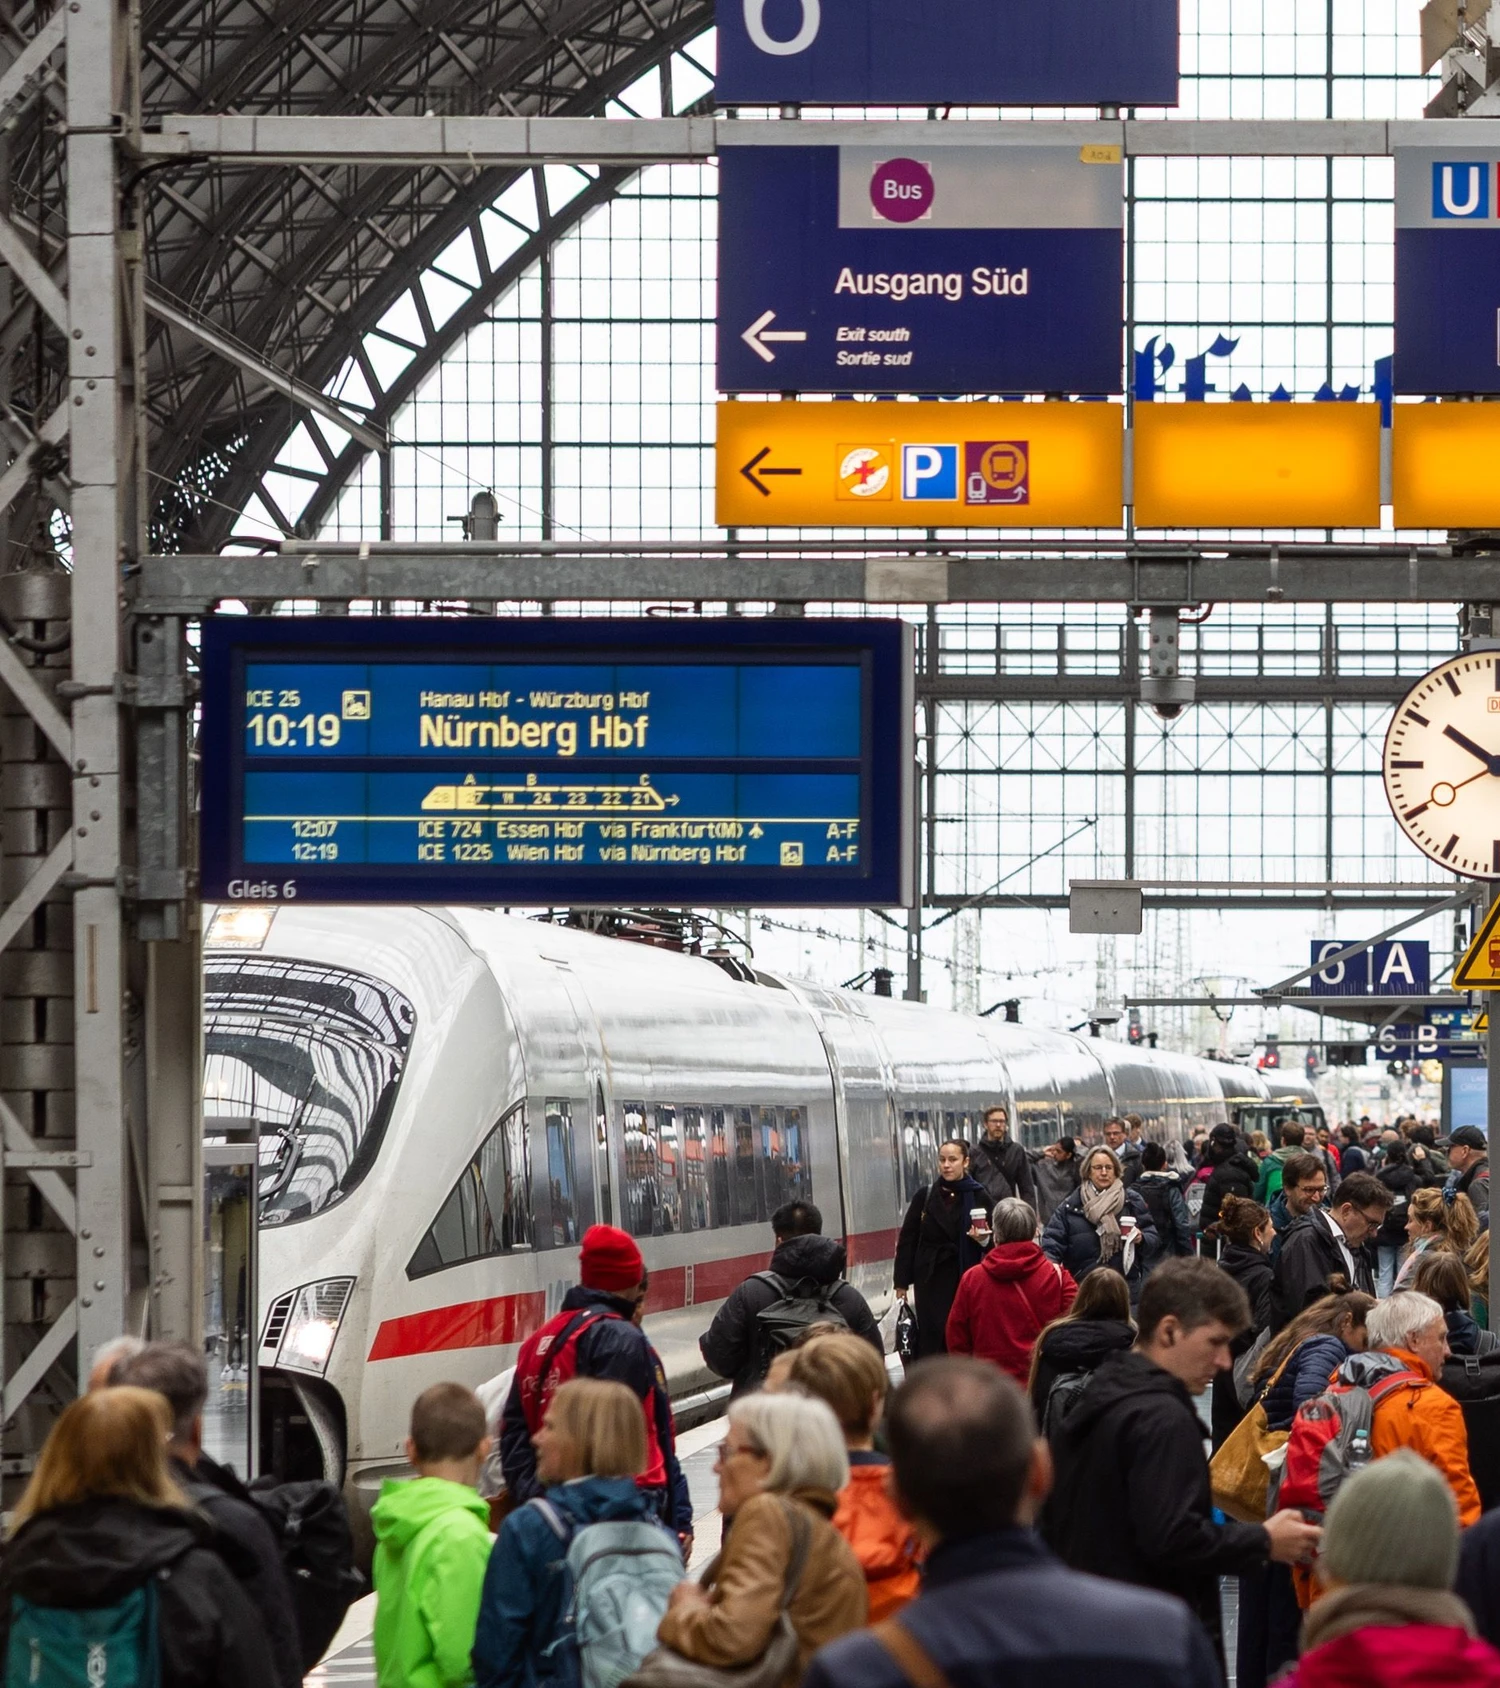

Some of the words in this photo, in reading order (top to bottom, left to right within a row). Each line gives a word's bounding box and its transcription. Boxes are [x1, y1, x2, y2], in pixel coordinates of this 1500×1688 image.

[884, 180, 922, 199] Bus
[1443, 167, 1479, 215] U
[835, 268, 962, 300] Ausgang
[972, 268, 1027, 295] Süd
[836, 327, 866, 342] Exit
[868, 328, 910, 342] south
[837, 351, 880, 365] Sortie
[883, 352, 912, 365] sud
[906, 447, 943, 498] P
[246, 690, 274, 708] ICE
[279, 690, 300, 707] 25
[421, 692, 474, 707] Hanau
[479, 691, 510, 707] Hbf
[530, 692, 613, 711] Würzburg
[620, 692, 649, 708] Hbf
[247, 714, 341, 746] 10:19
[420, 715, 576, 755] Nürnberg
[591, 716, 648, 747] Hbf
[463, 773, 477, 786] A
[526, 774, 537, 786] B
[639, 774, 650, 786] C
[568, 792, 587, 804] 23
[602, 792, 622, 804] 22
[632, 792, 650, 804] 21
[291, 821, 338, 838] 12:07
[418, 821, 445, 838] ICE
[450, 821, 482, 838] 724
[496, 821, 549, 838] Essen
[555, 823, 585, 839] Hbf
[600, 822, 627, 839] via
[631, 822, 744, 840] Frankfurt(M)
[826, 822, 859, 839] A-F
[291, 844, 338, 860] 12:19
[418, 844, 445, 860] ICE
[451, 844, 494, 860] 1225
[506, 844, 550, 861] Wien
[554, 845, 585, 861] Hbf
[600, 845, 627, 862] via
[631, 844, 711, 865] Nürnberg
[715, 844, 747, 861] Hbf
[826, 845, 859, 862] A-F
[228, 880, 277, 898] Gleis
[283, 880, 296, 898] 6
[1317, 942, 1346, 985] 6
[1380, 942, 1415, 985] A
[1379, 1025, 1397, 1054] 6
[1417, 1025, 1438, 1053] B
